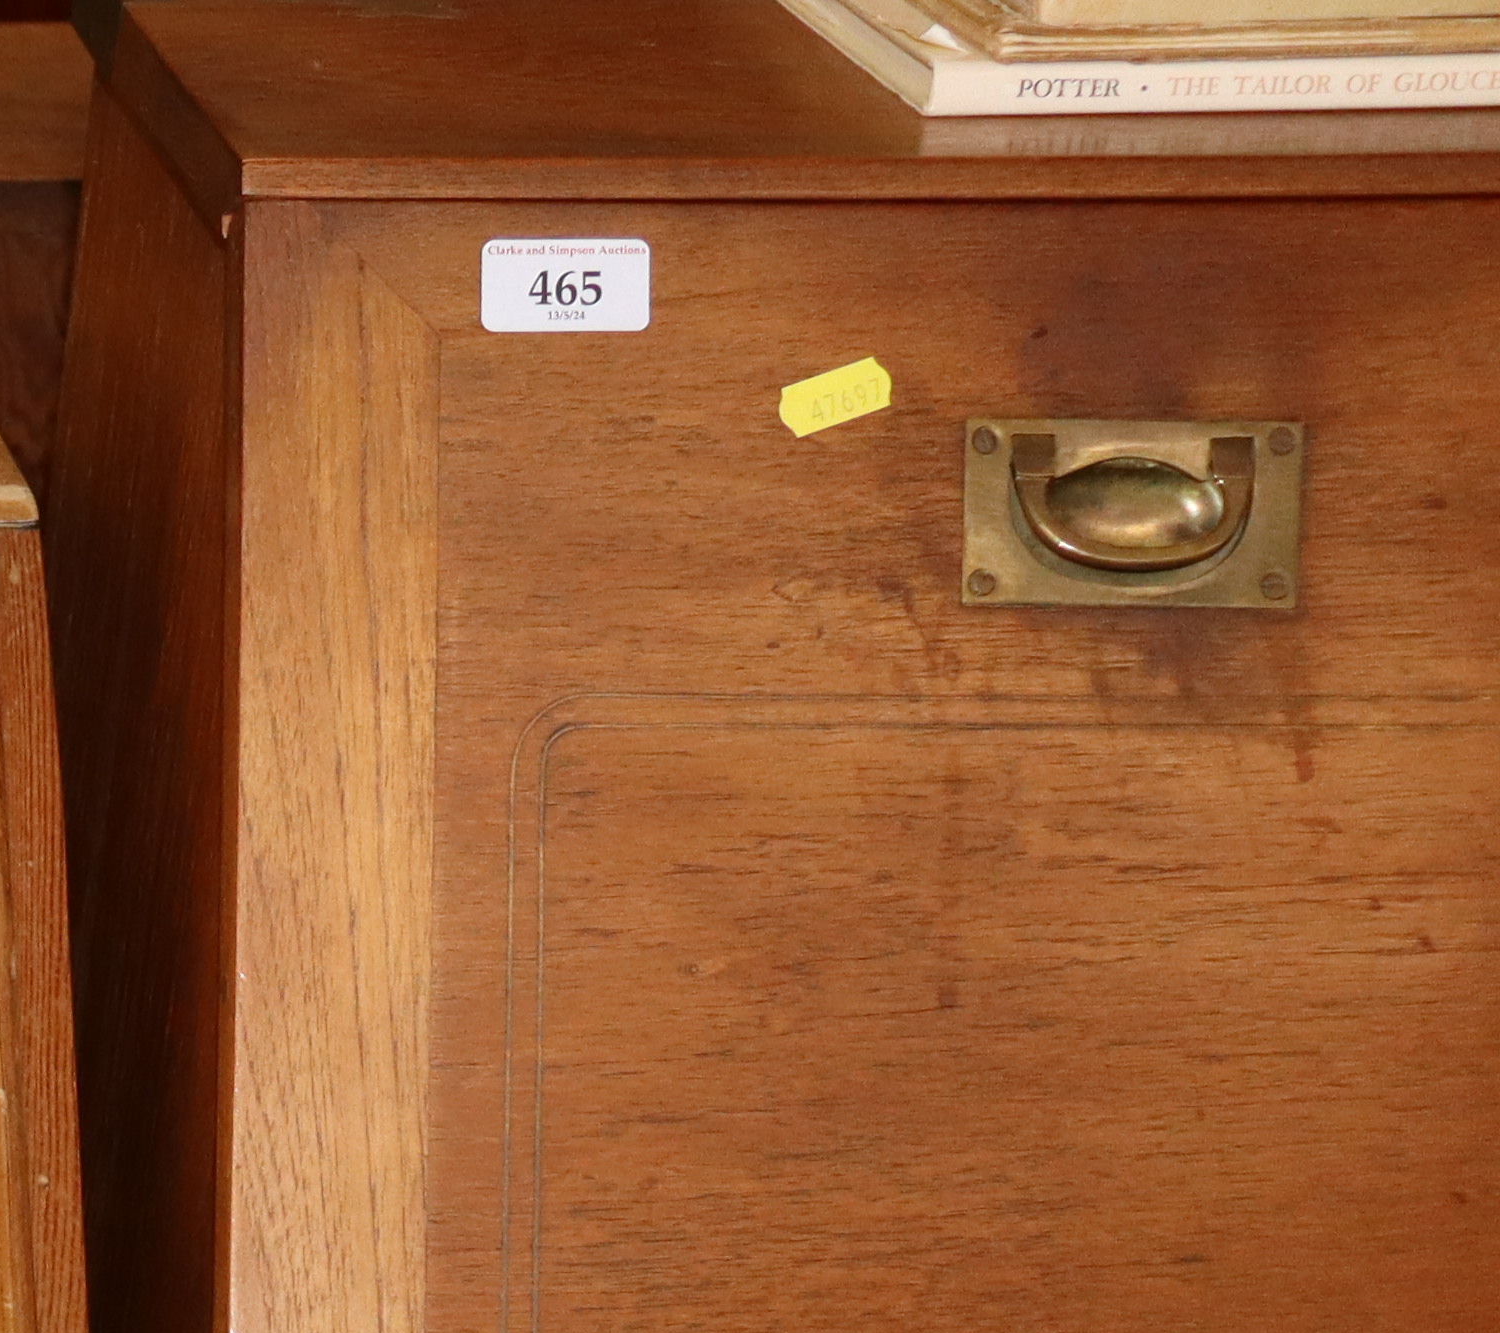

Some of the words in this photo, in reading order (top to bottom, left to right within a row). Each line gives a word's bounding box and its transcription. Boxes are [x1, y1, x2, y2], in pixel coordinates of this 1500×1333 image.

[1016, 78, 1120, 98] POTTER
[1168, 76, 1220, 96] THE
[1234, 75, 1332, 96] TAILOR
[1346, 74, 1382, 94] OF
[487, 245, 523, 255] Clarke
[526, 245, 545, 255] and
[549, 244, 595, 257] Simpson
[598, 244, 647, 255] Auctions
[528, 270, 603, 306] 465
[547, 311, 585, 321] 13/5/24
[811, 377, 881, 422] 47697
